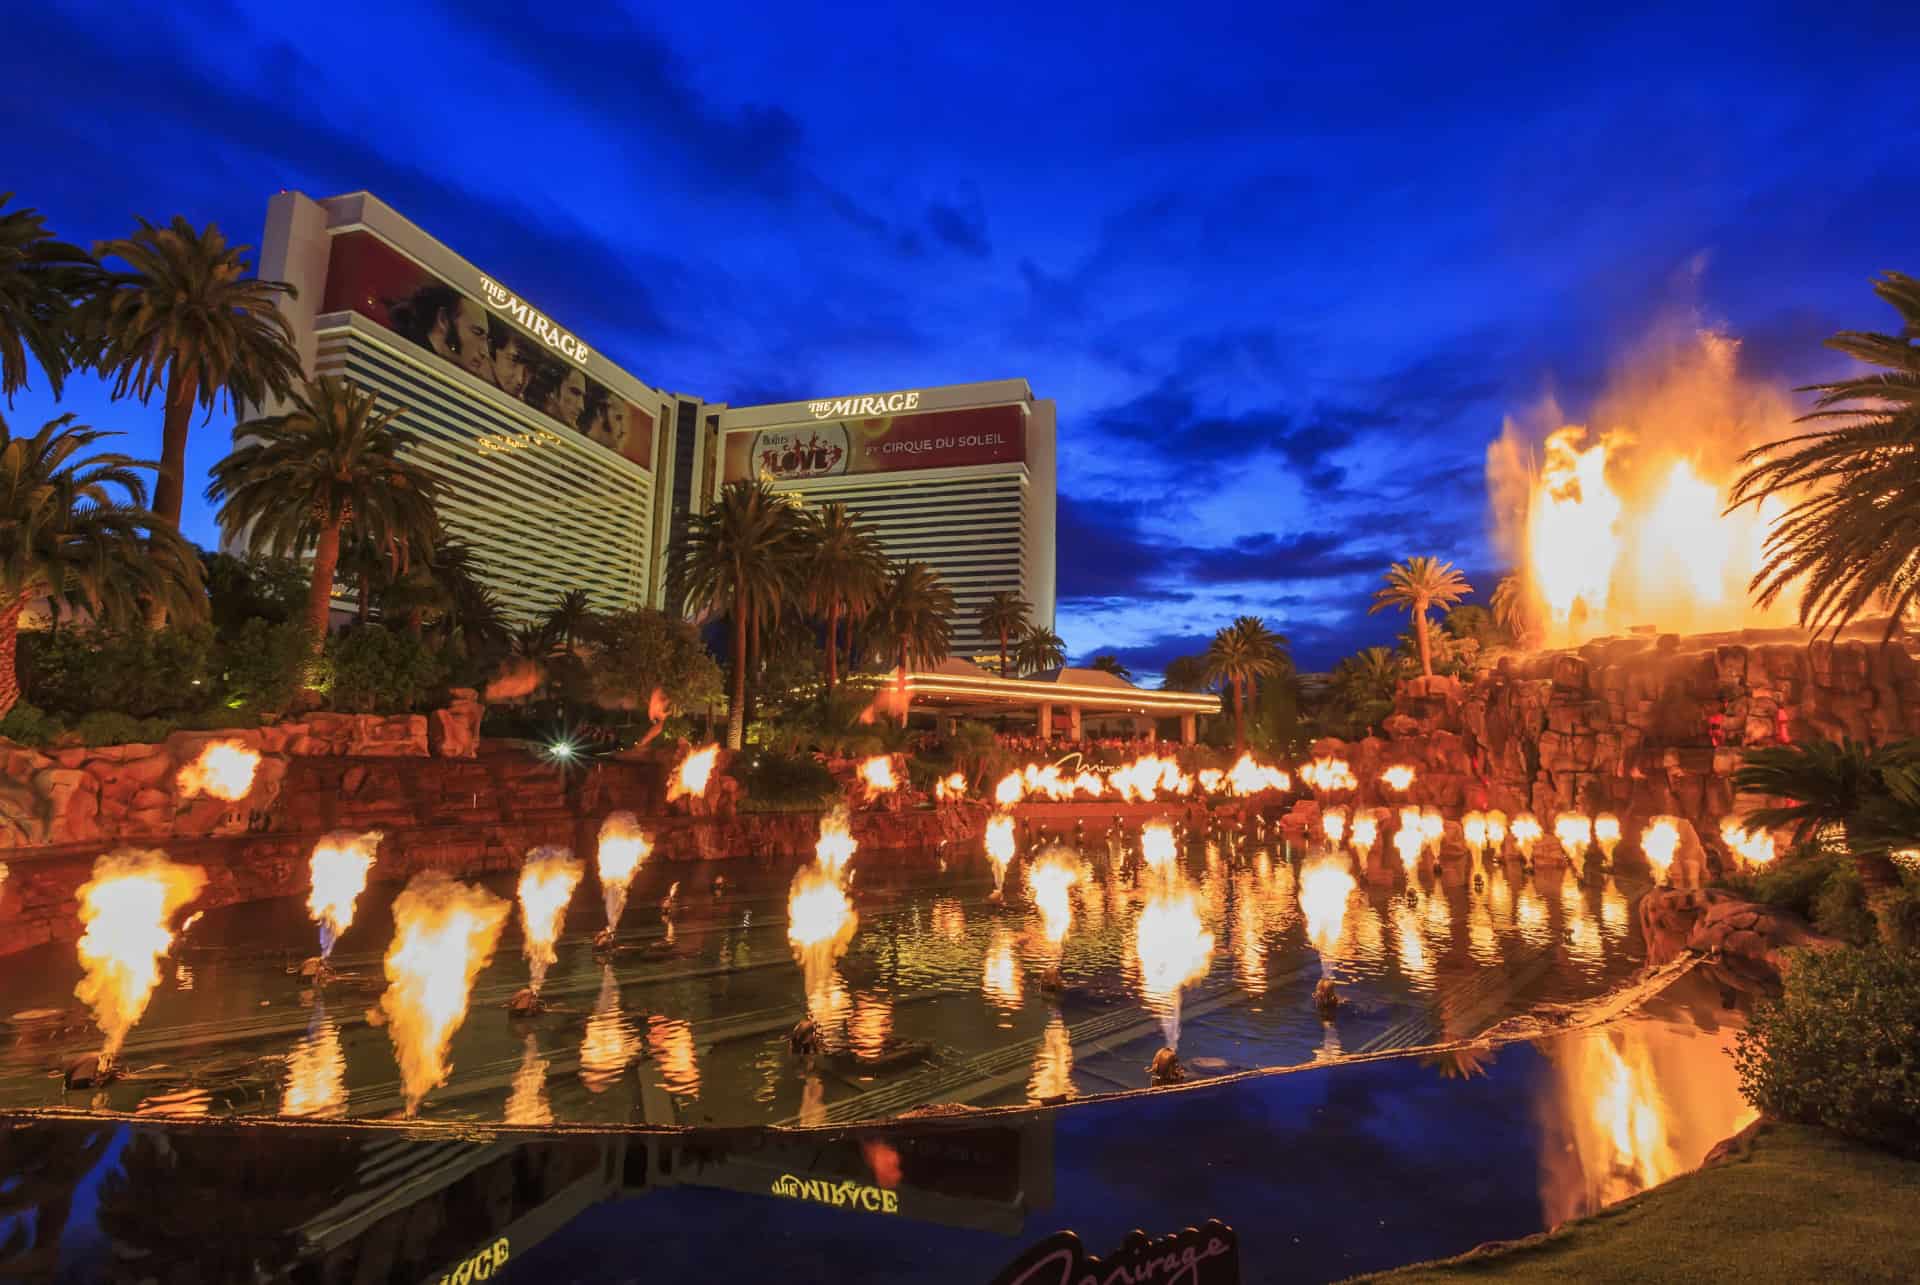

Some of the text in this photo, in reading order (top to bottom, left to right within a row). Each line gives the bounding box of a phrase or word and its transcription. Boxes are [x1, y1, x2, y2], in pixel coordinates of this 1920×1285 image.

[480, 276, 588, 364] THE MIRAGE
[808, 392, 919, 419] THE MIRAGE
[882, 440, 933, 455] CIRQUE
[935, 437, 954, 449] DU
[958, 433, 1006, 447] SOLEIL
